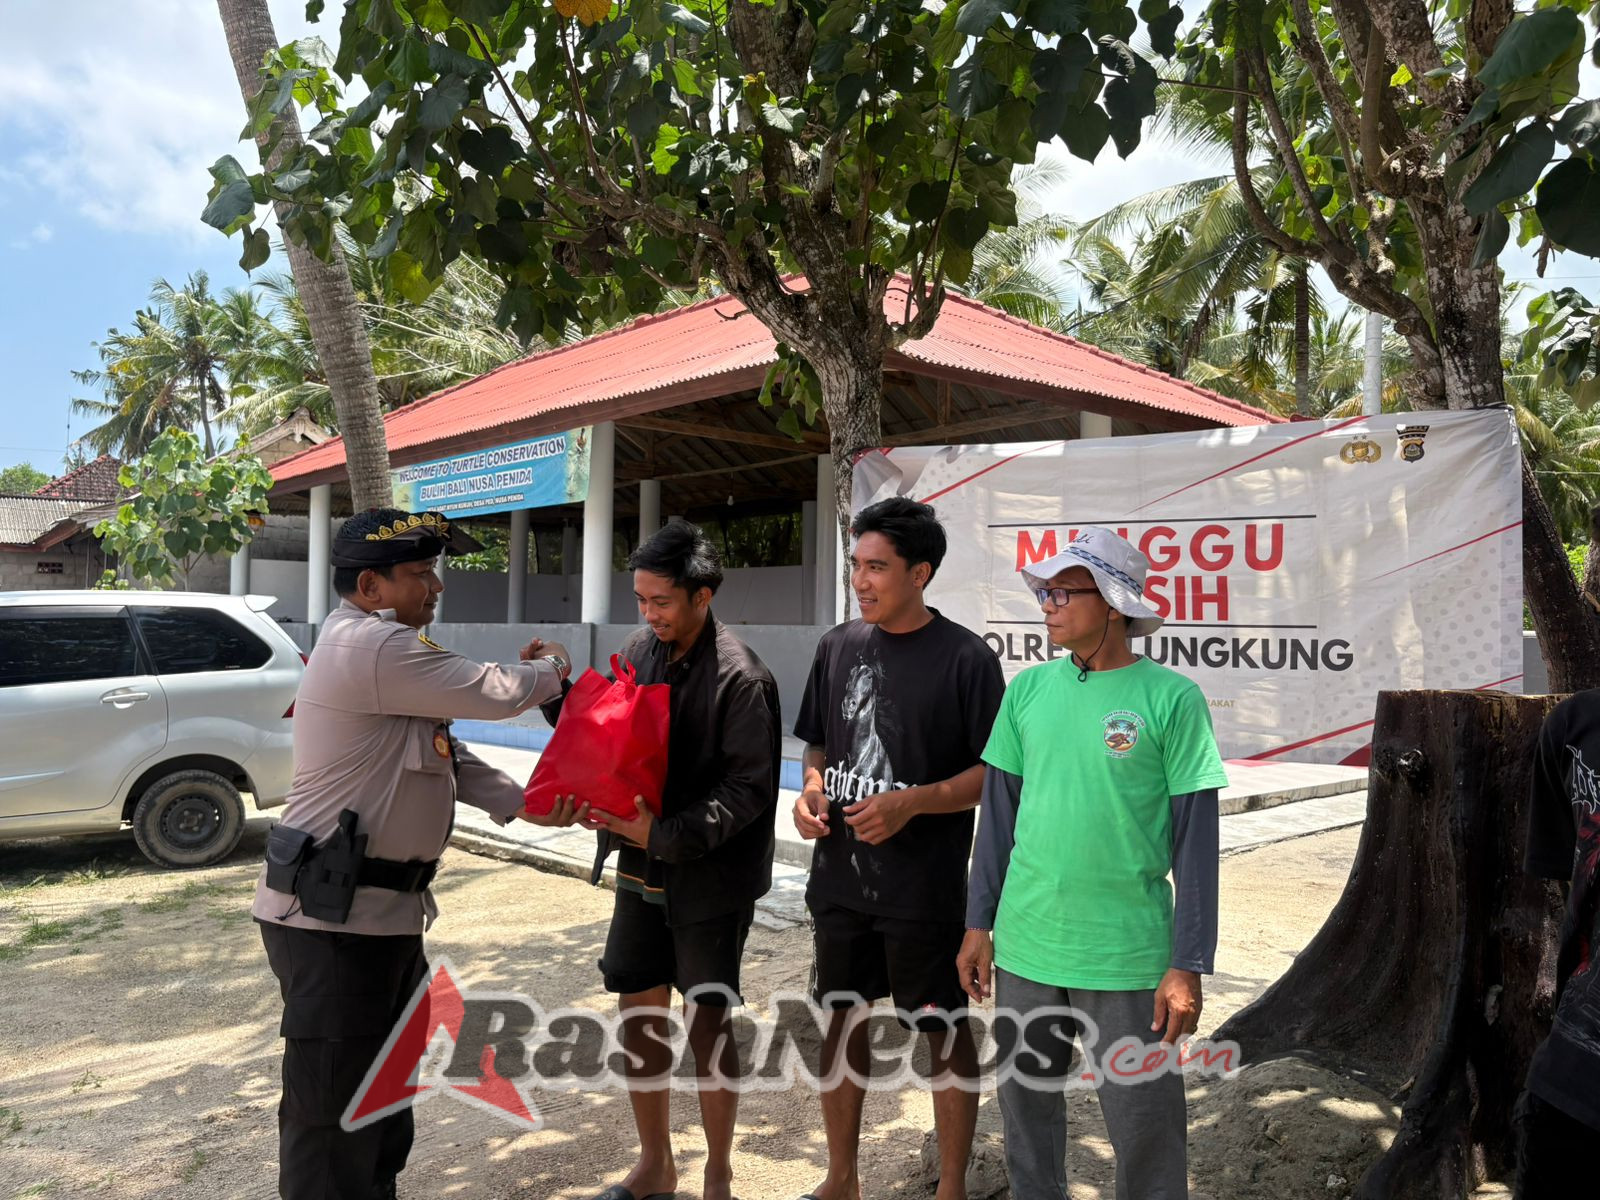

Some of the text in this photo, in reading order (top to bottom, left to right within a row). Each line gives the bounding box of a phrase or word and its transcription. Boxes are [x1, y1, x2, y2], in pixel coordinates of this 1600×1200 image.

[400, 437, 566, 483] WELCOME TO TURTLE CONSERVATION
[421, 468, 532, 501] BULIH BALI NUSA PENIDA
[1015, 523, 1284, 573] MGGU
[1143, 575, 1229, 621] SIH
[982, 632, 1354, 673] OLRE UNGKUNG
